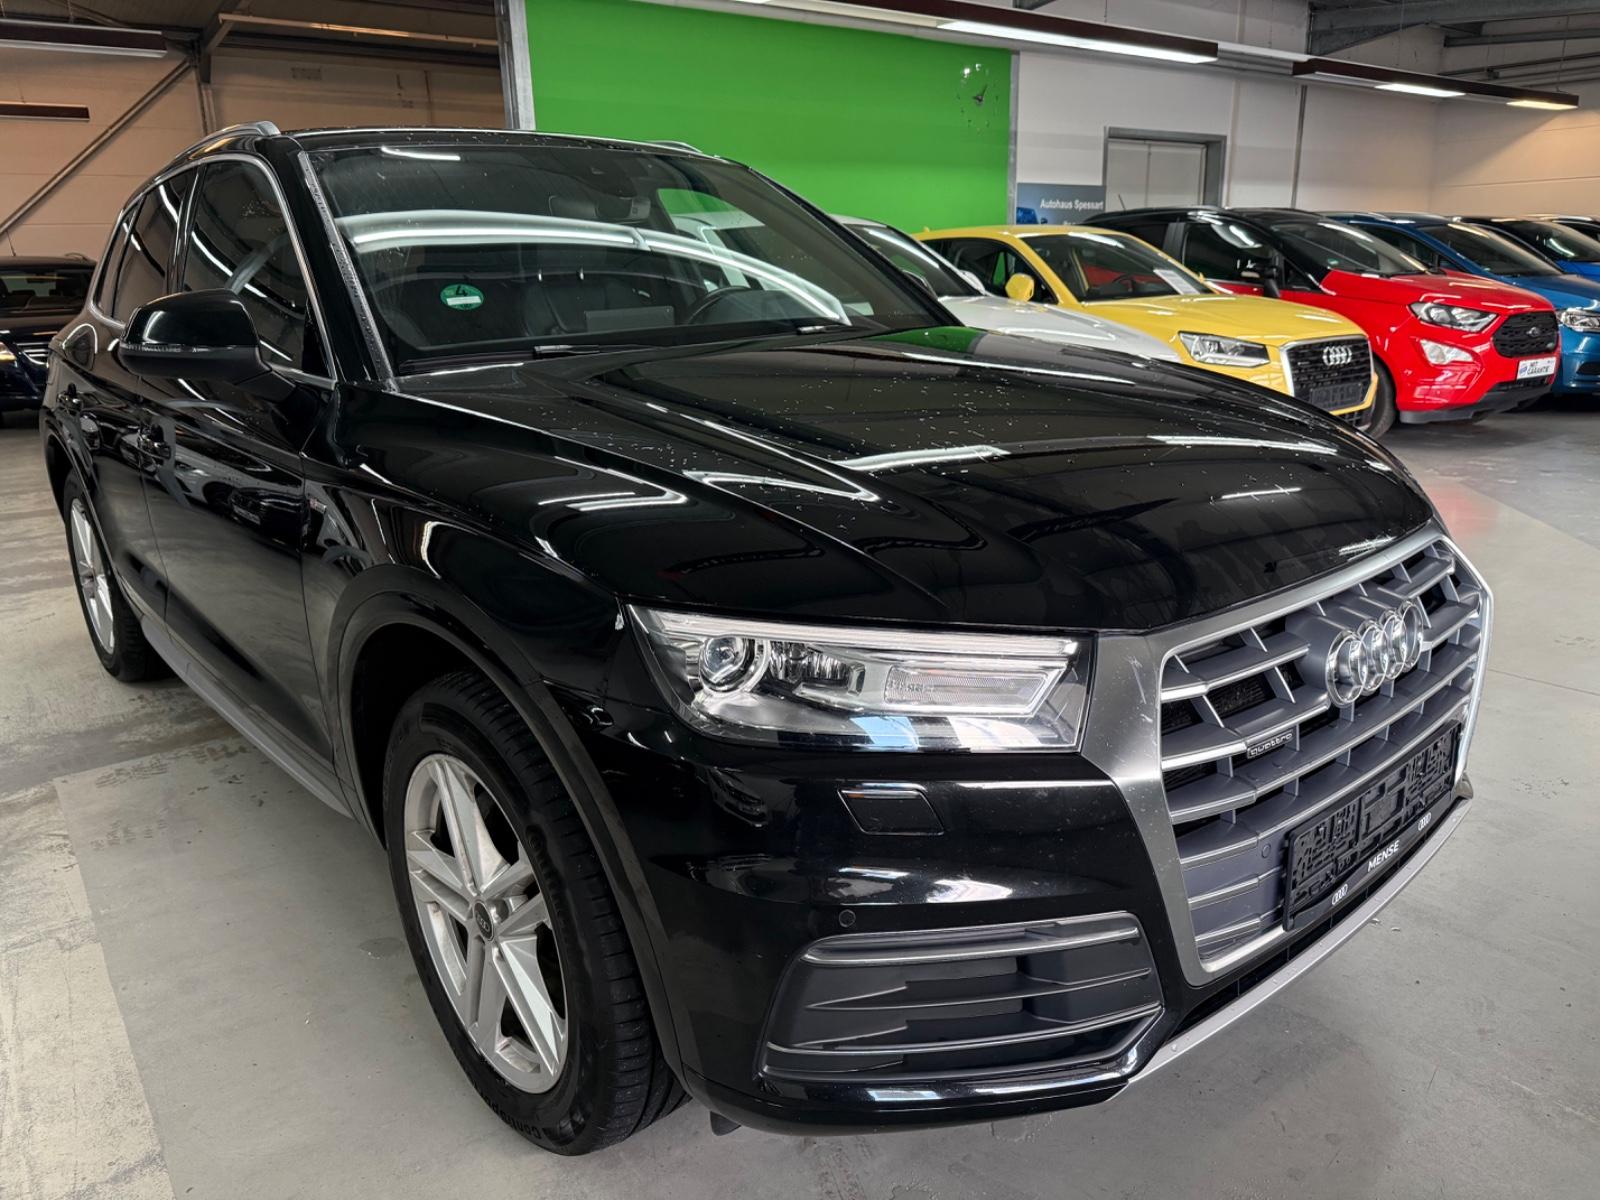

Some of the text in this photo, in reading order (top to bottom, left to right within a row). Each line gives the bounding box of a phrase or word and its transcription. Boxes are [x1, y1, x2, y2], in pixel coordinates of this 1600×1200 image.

[1040, 198, 1104, 212] Autohaus Spessart
[455, 285, 469, 296] 4
[1250, 732, 1293, 755] quattro
[1367, 839, 1400, 873] MENSE
